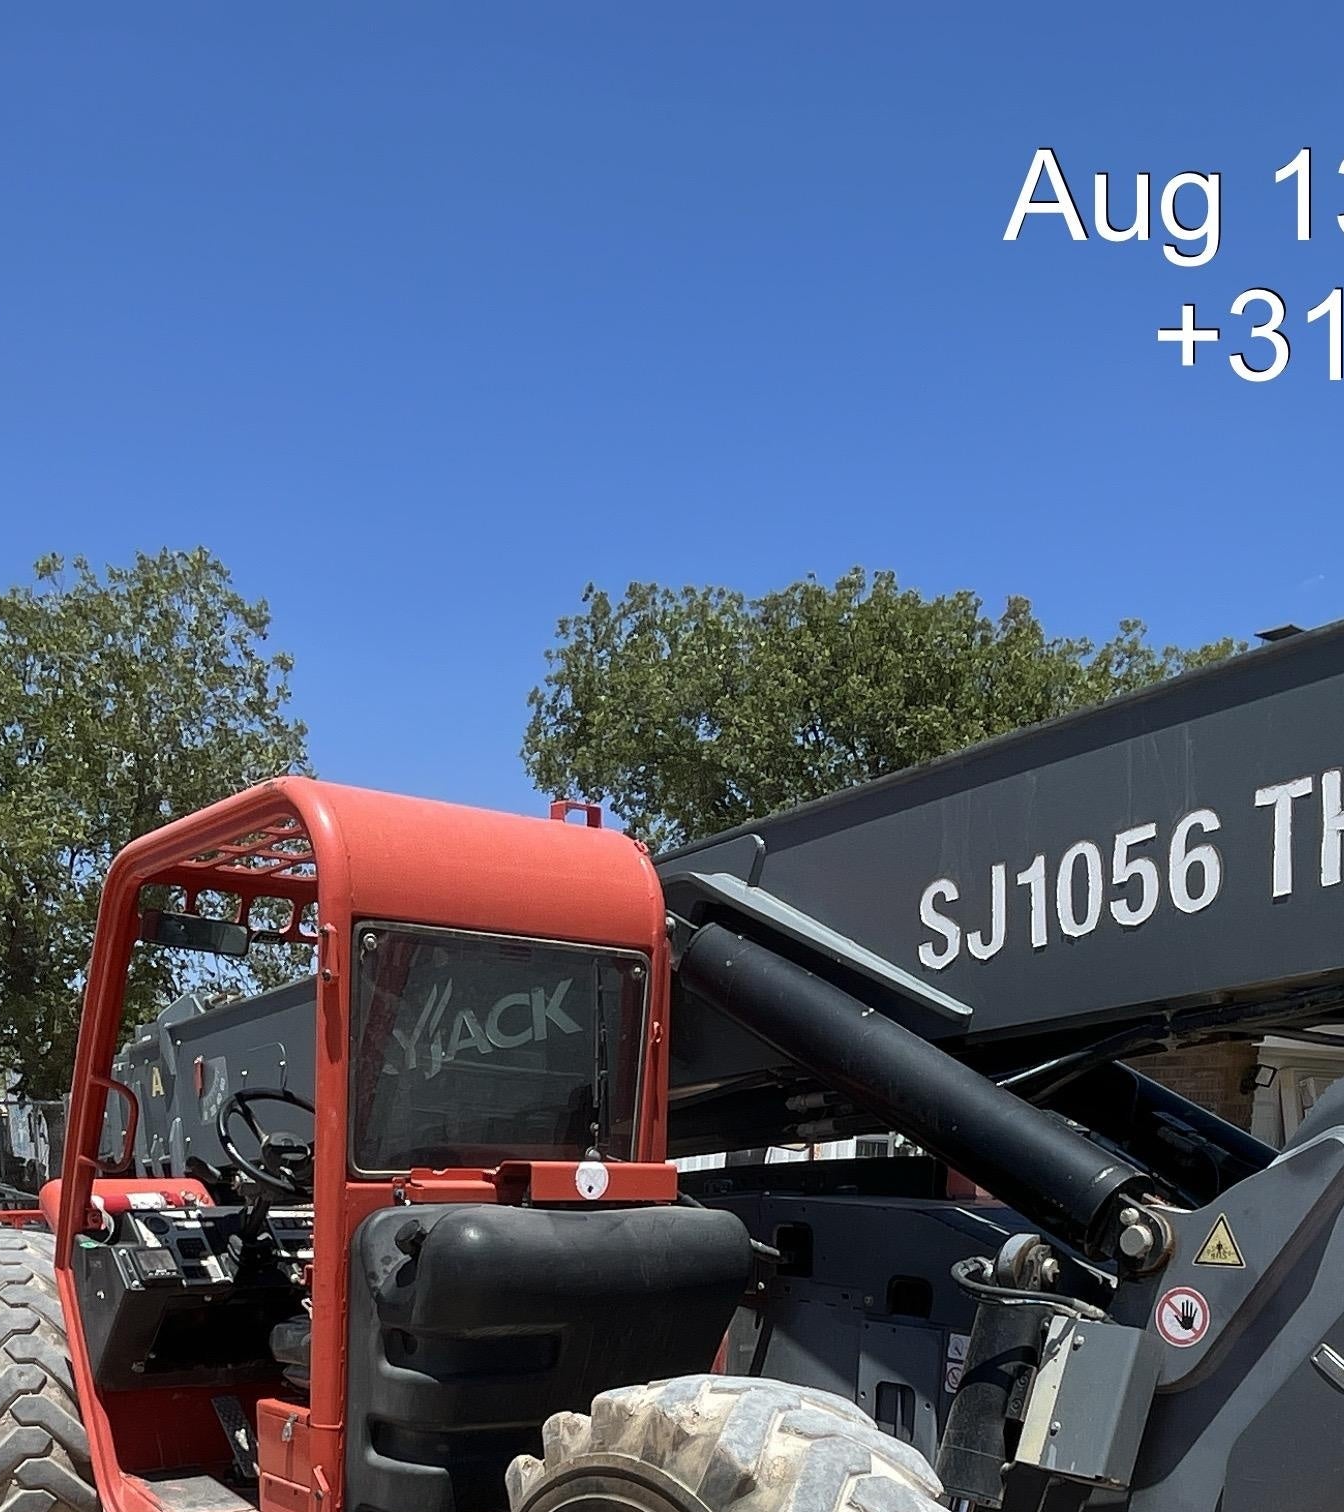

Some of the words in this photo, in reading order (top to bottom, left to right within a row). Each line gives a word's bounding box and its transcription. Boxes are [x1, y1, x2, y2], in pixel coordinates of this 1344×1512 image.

[917, 808, 1222, 970] SJ1056
[382, 977, 584, 1080] YJACK
[151, 1066, 165, 1098] A
